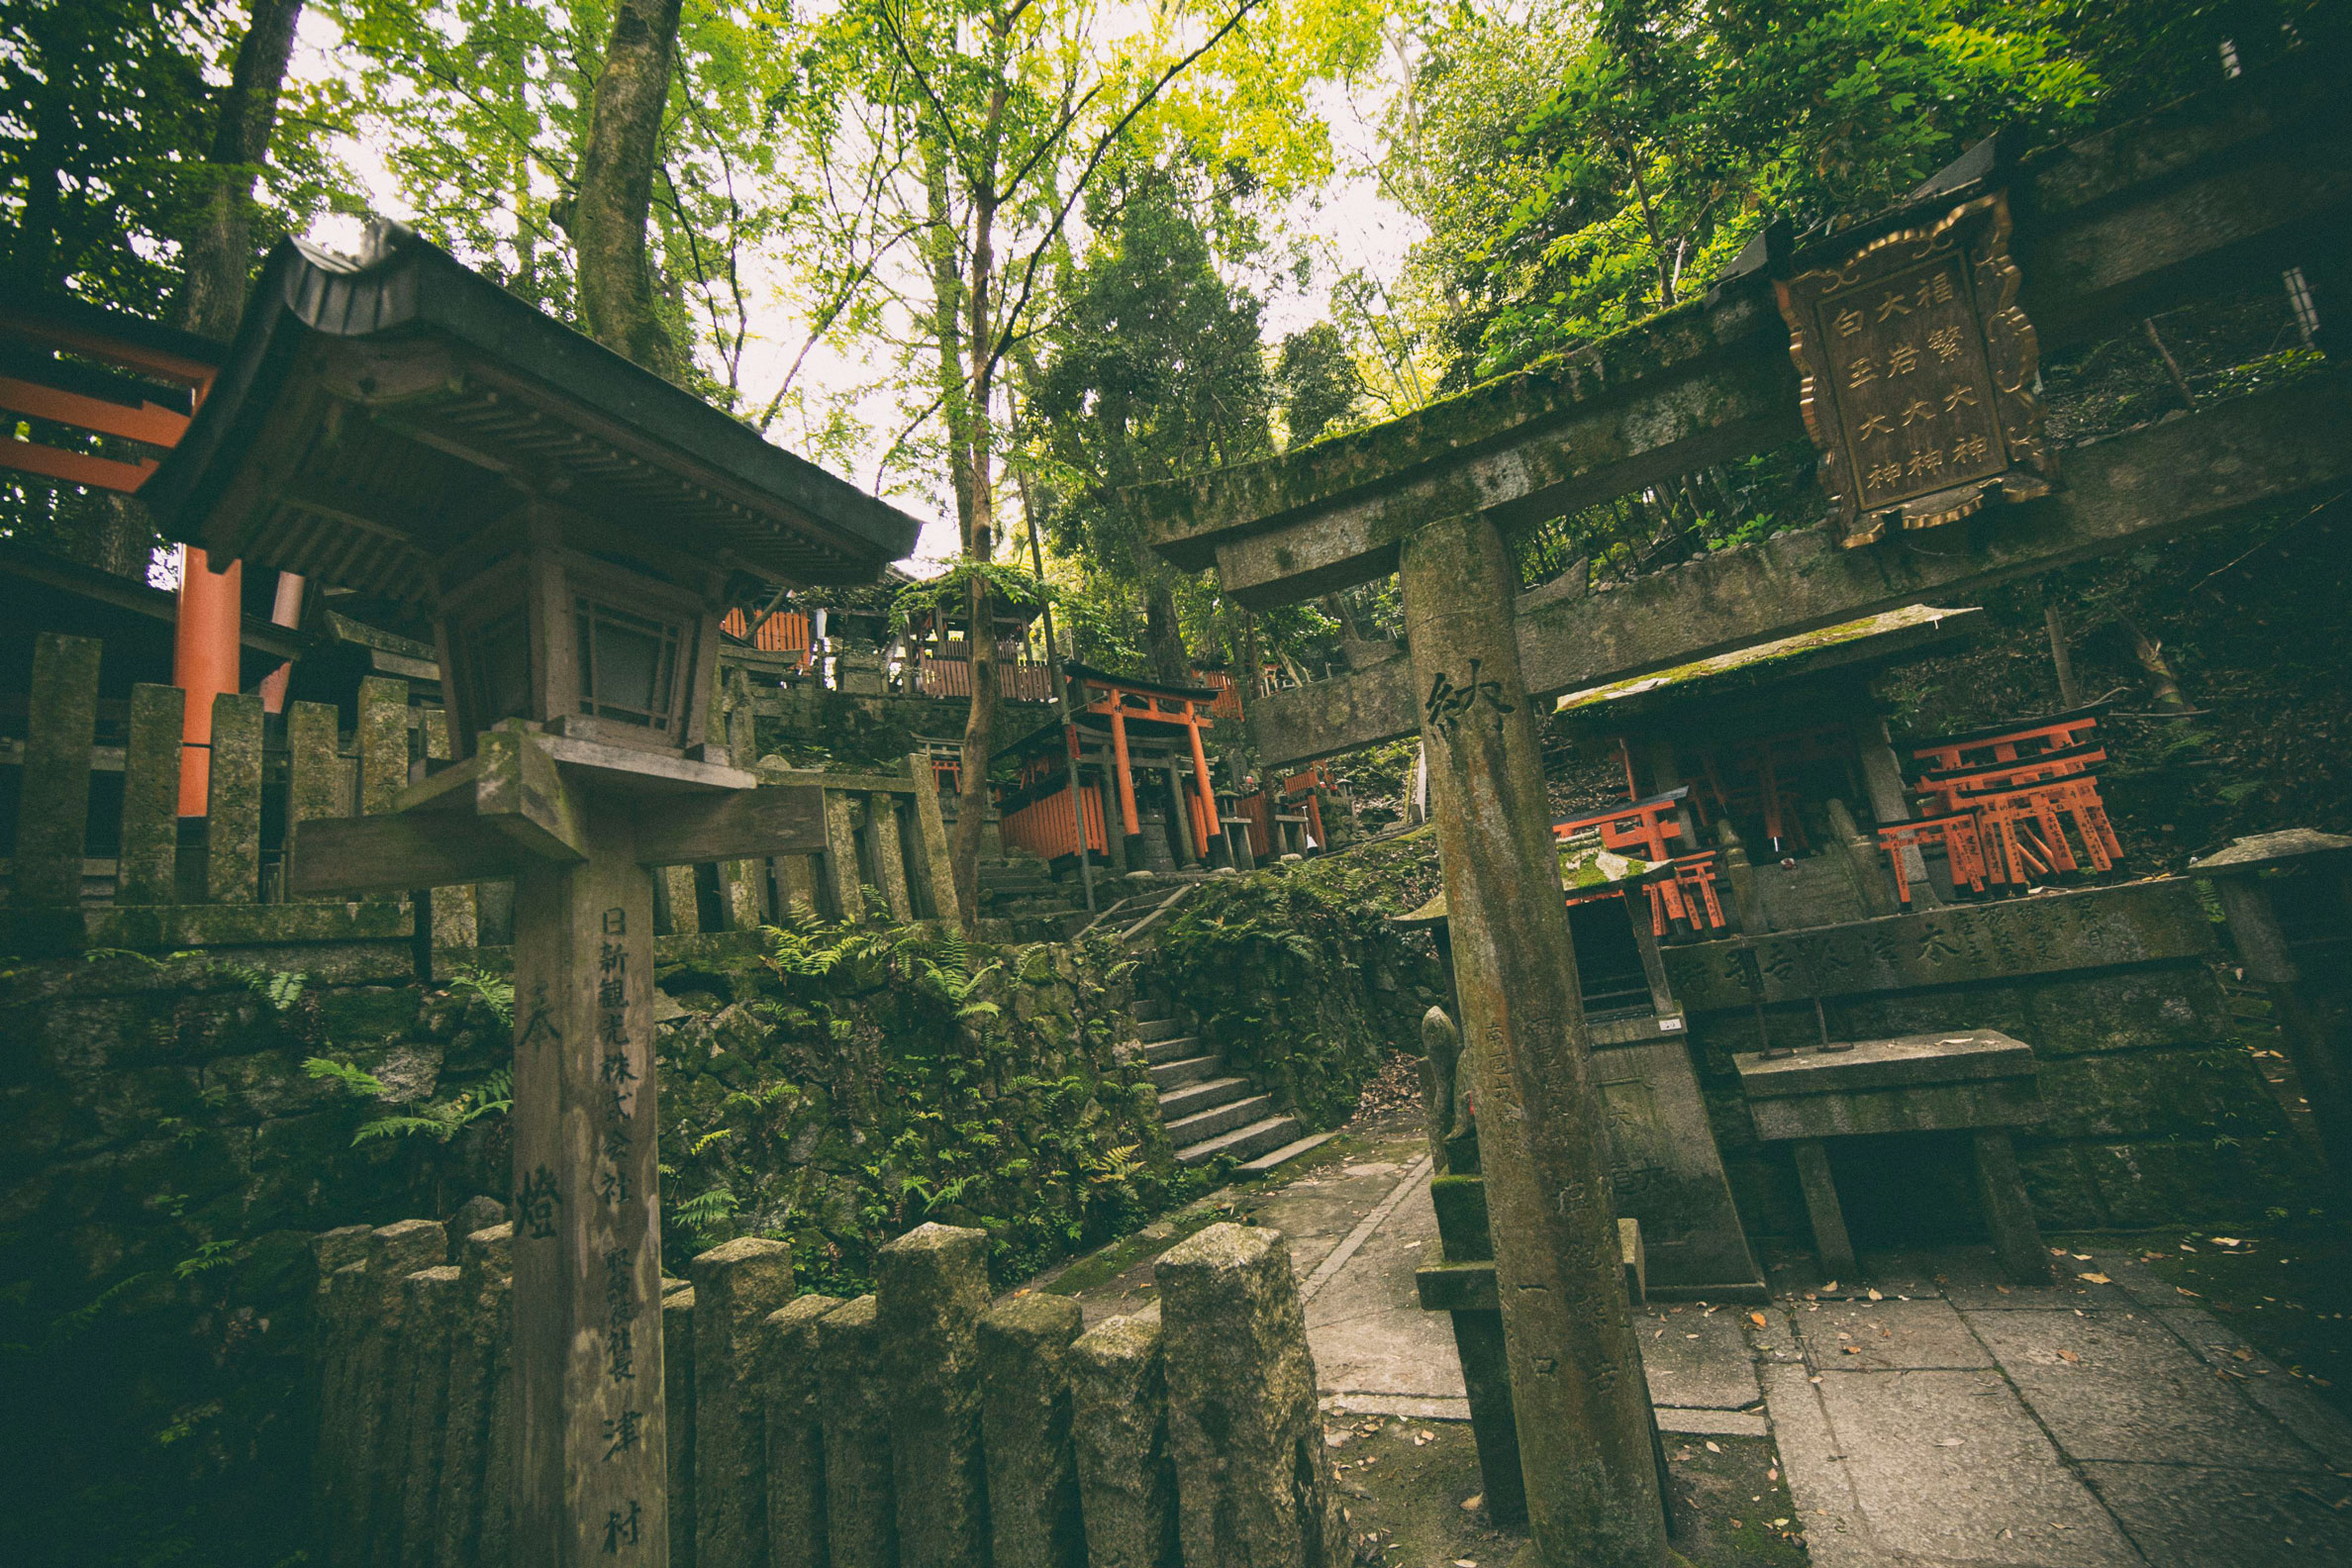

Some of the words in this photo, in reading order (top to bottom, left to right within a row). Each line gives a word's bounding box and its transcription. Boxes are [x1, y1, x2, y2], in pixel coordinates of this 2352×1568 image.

[1831, 308, 1903, 490] 白玉大神
[1876, 291, 1943, 477] 大岩大神
[1914, 271, 1989, 463] 福繁大神
[598, 906, 638, 1204] 日新観光株式会社
